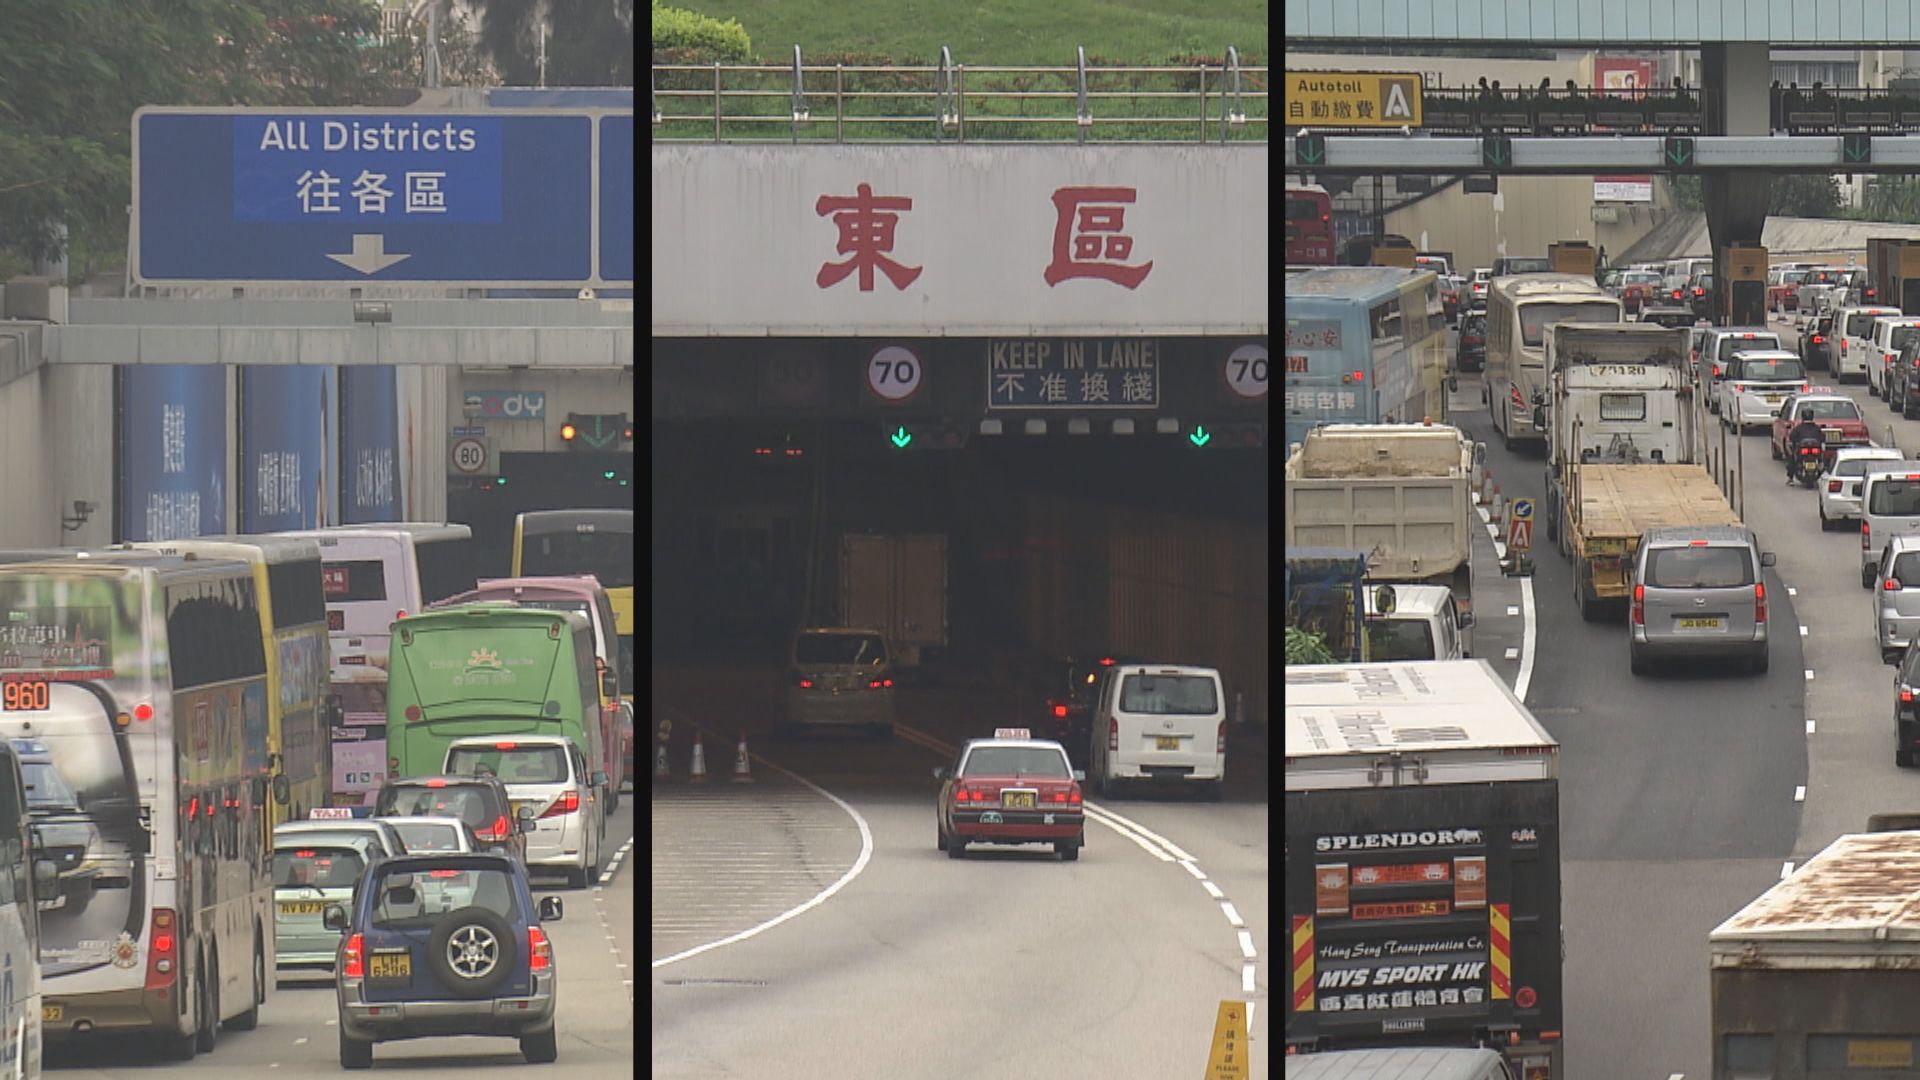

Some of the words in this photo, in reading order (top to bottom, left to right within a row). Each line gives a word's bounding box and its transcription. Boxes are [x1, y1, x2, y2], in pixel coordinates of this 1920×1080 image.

[1298, 79, 1362, 93] Autotoll
[1290, 100, 1374, 119] 自動繳費
[260, 121, 309, 151] All
[324, 121, 476, 152] Districts
[296, 169, 447, 214] 往各區
[816, 183, 1154, 292] 東區
[993, 341, 1050, 370] KEEP
[1063, 341, 1085, 370] IN
[1097, 341, 1154, 370] LANE
[875, 360, 915, 384] 70
[461, 448, 479, 464] 80
[4, 682, 48, 710] 960
[313, 808, 351, 818] TAXI
[1316, 831, 1455, 851] SPLENDOR
[1318, 968, 1370, 988] MYS
[1373, 964, 1449, 986] SPORT
[1451, 961, 1486, 980] HK
